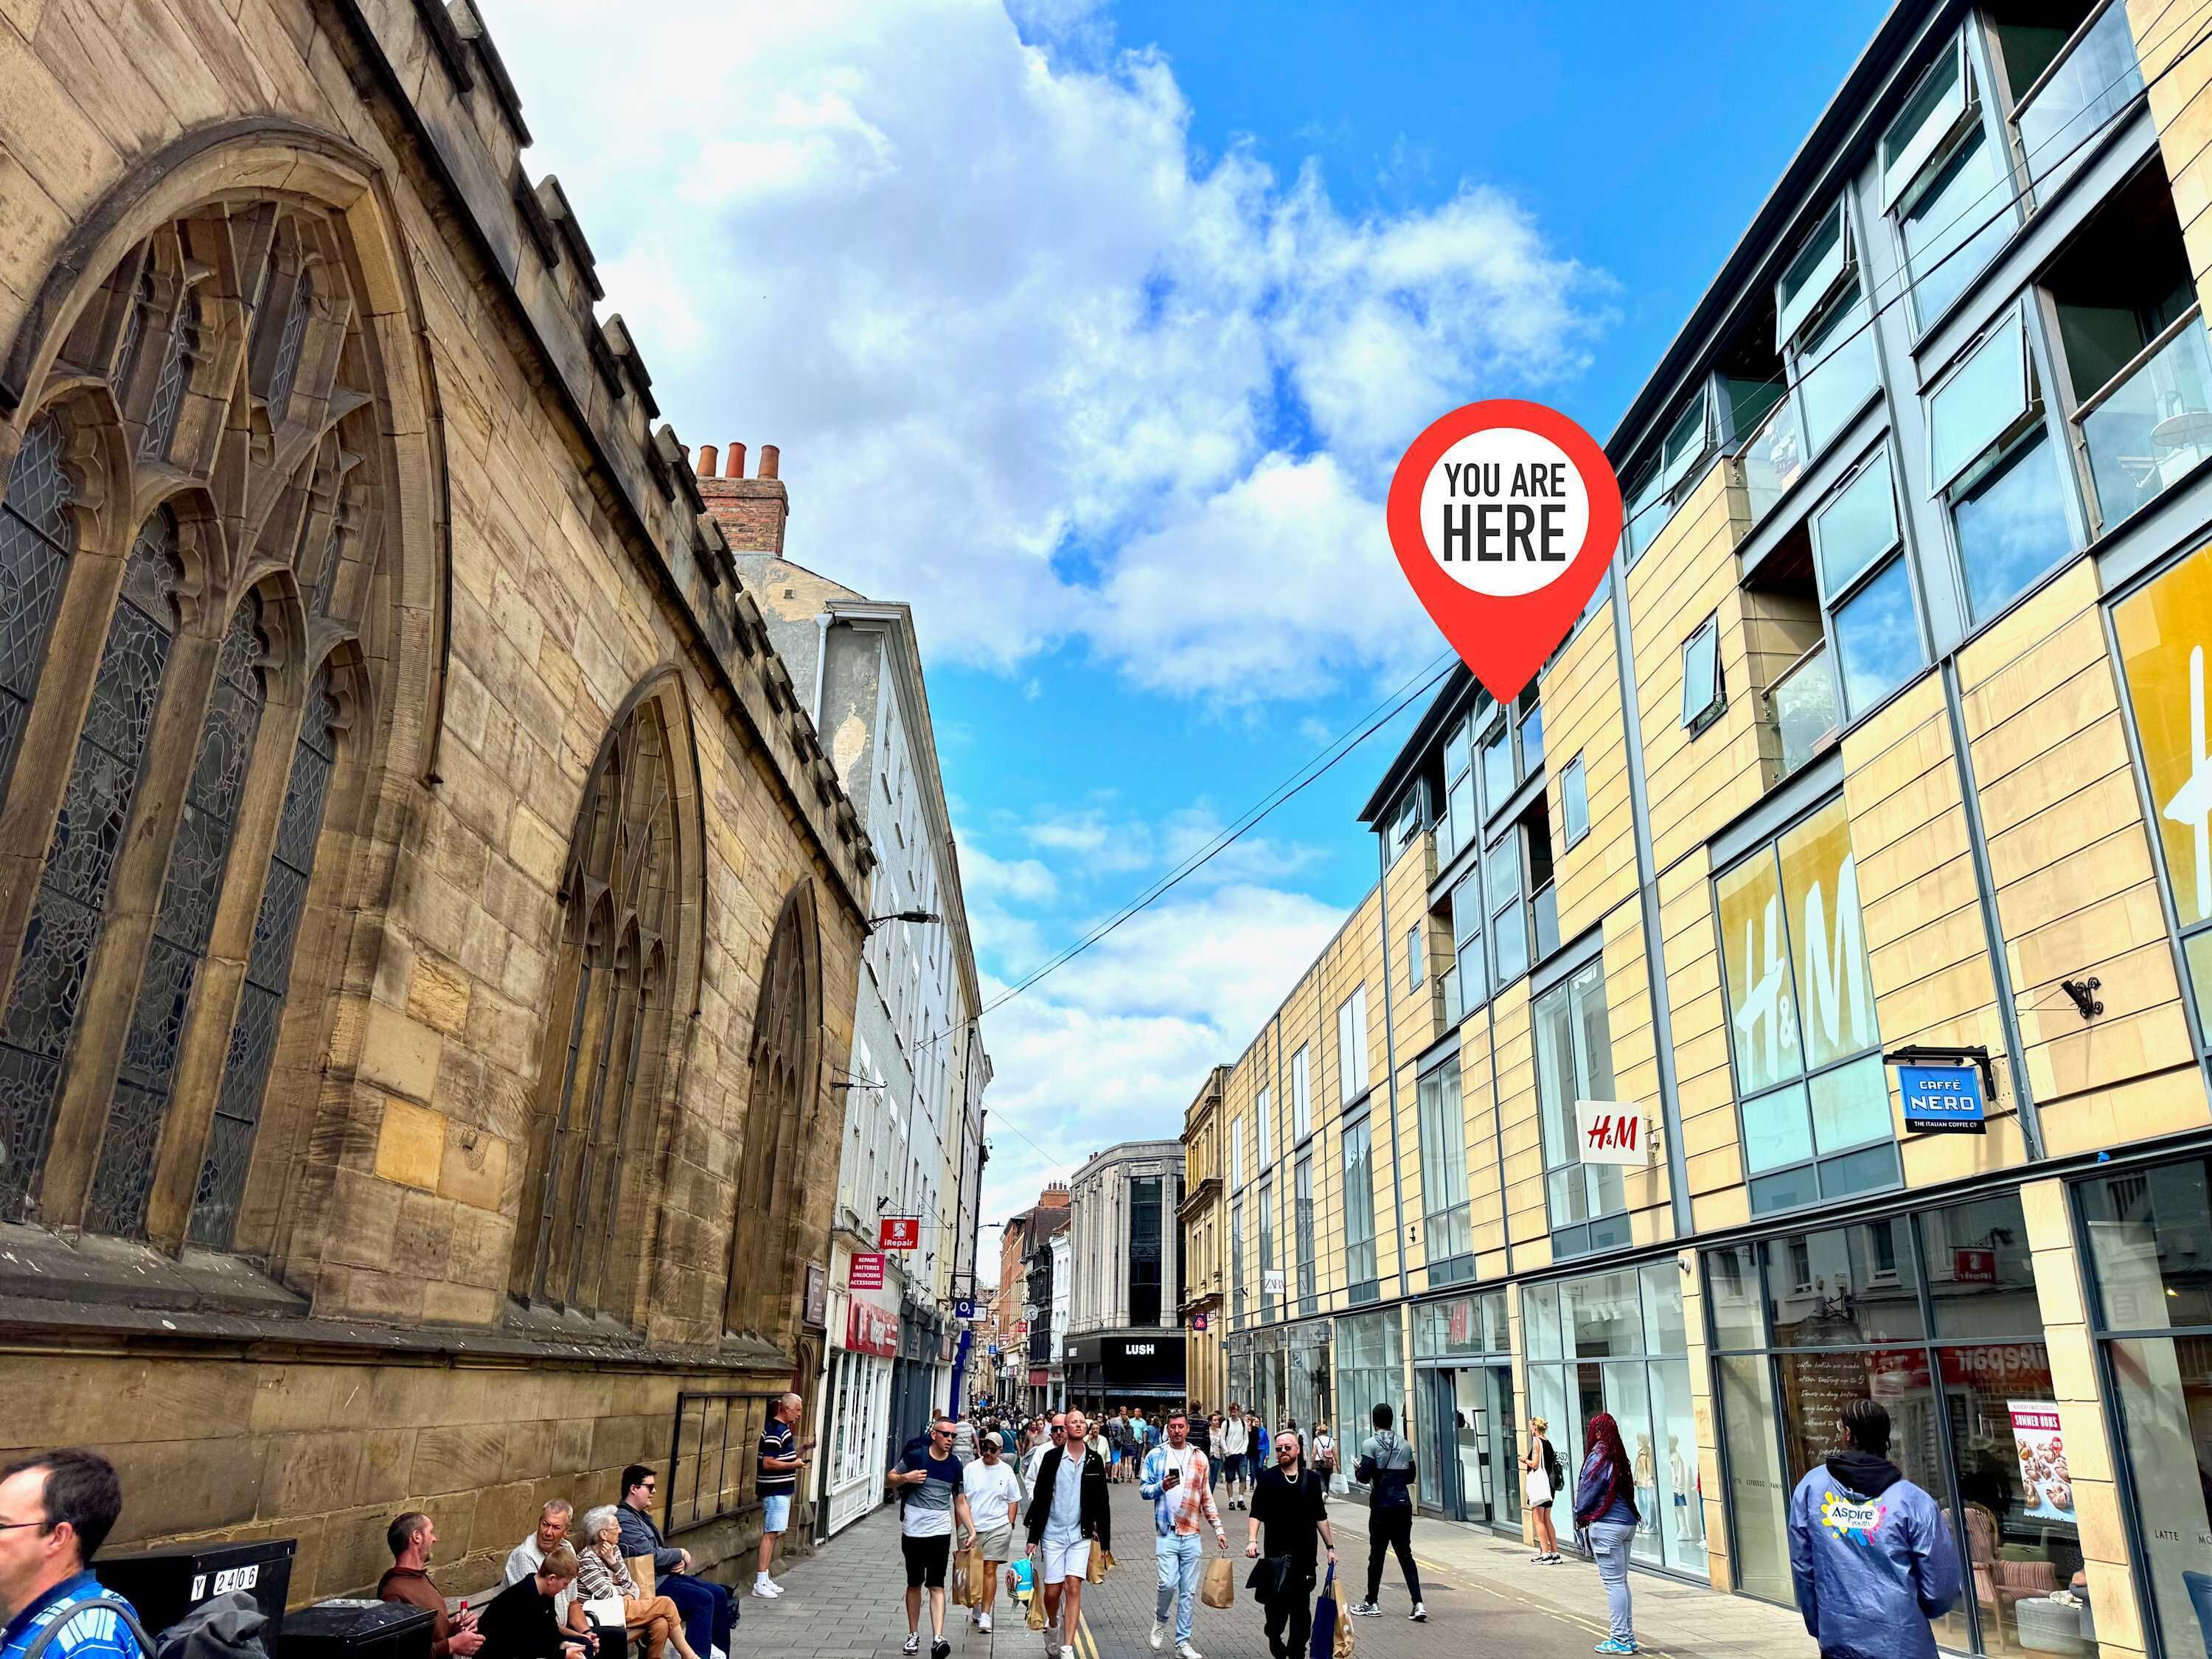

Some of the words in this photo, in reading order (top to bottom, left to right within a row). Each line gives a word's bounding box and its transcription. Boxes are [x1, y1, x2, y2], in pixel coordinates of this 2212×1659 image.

[1735, 852, 1868, 1093] H&M
[1910, 1095, 1975, 1110] NERO
[1587, 1115, 1638, 1152] H&M
[884, 1239, 914, 1248] iRepair
[1126, 1344, 1155, 1355] LUSH
[1858, 1375, 1864, 1385] 5
[2014, 1414, 2039, 1427] SUMMER
[1832, 1506, 1874, 1523] Aspire
[2154, 1528, 2179, 1540] LATTE
[195, 1579, 204, 1597] Y
[217, 1568, 256, 1591] 2406
